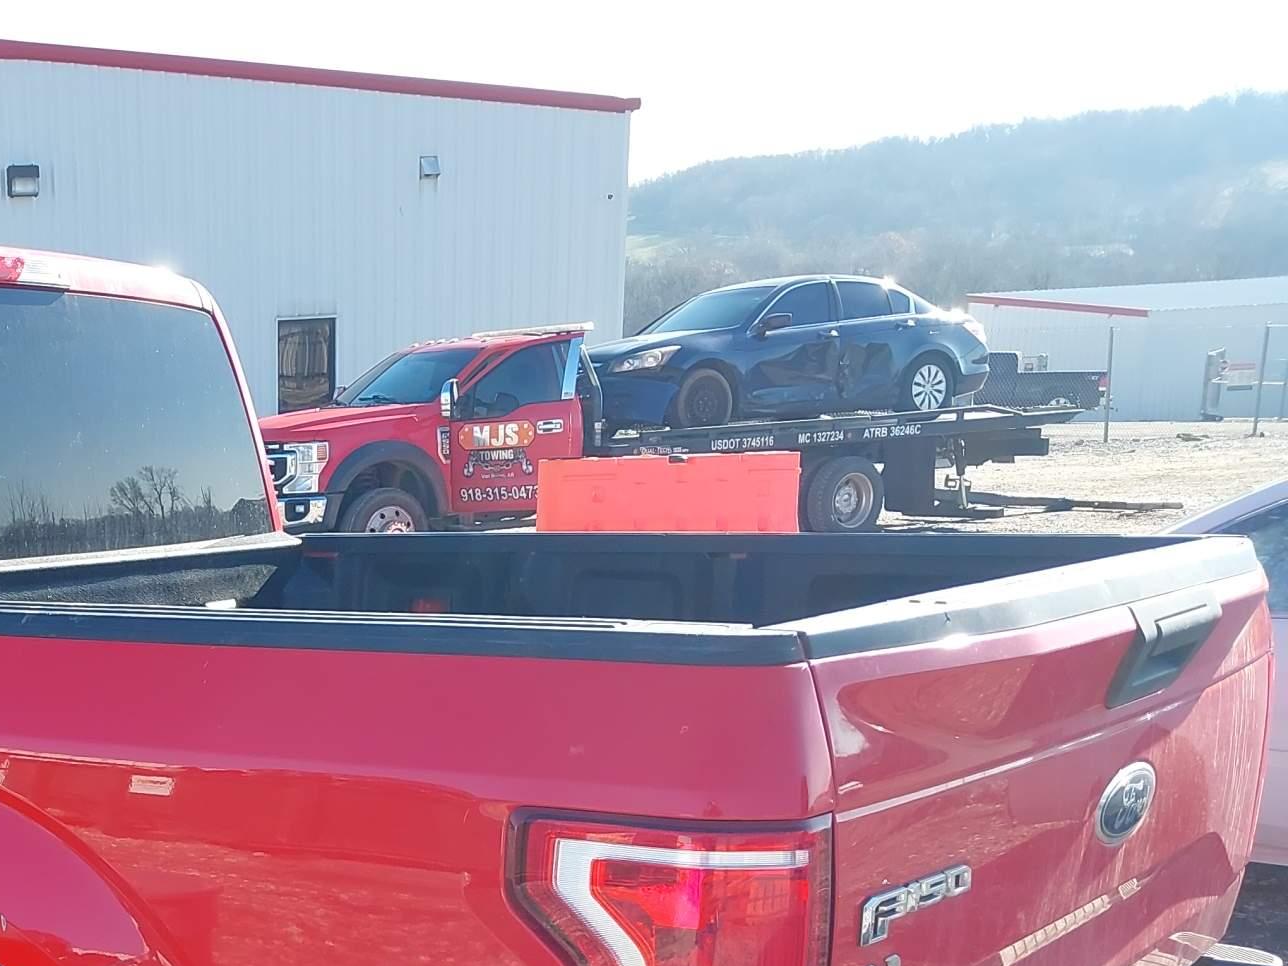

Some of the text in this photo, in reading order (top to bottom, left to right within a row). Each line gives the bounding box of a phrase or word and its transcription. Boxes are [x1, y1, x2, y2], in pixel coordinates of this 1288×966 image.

[473, 423, 519, 447] MJS
[798, 430, 844, 444] MC 1327234
[863, 427, 888, 439] ATRB
[711, 436, 774, 451] USDOT 3745116
[479, 449, 514, 461] TOWING
